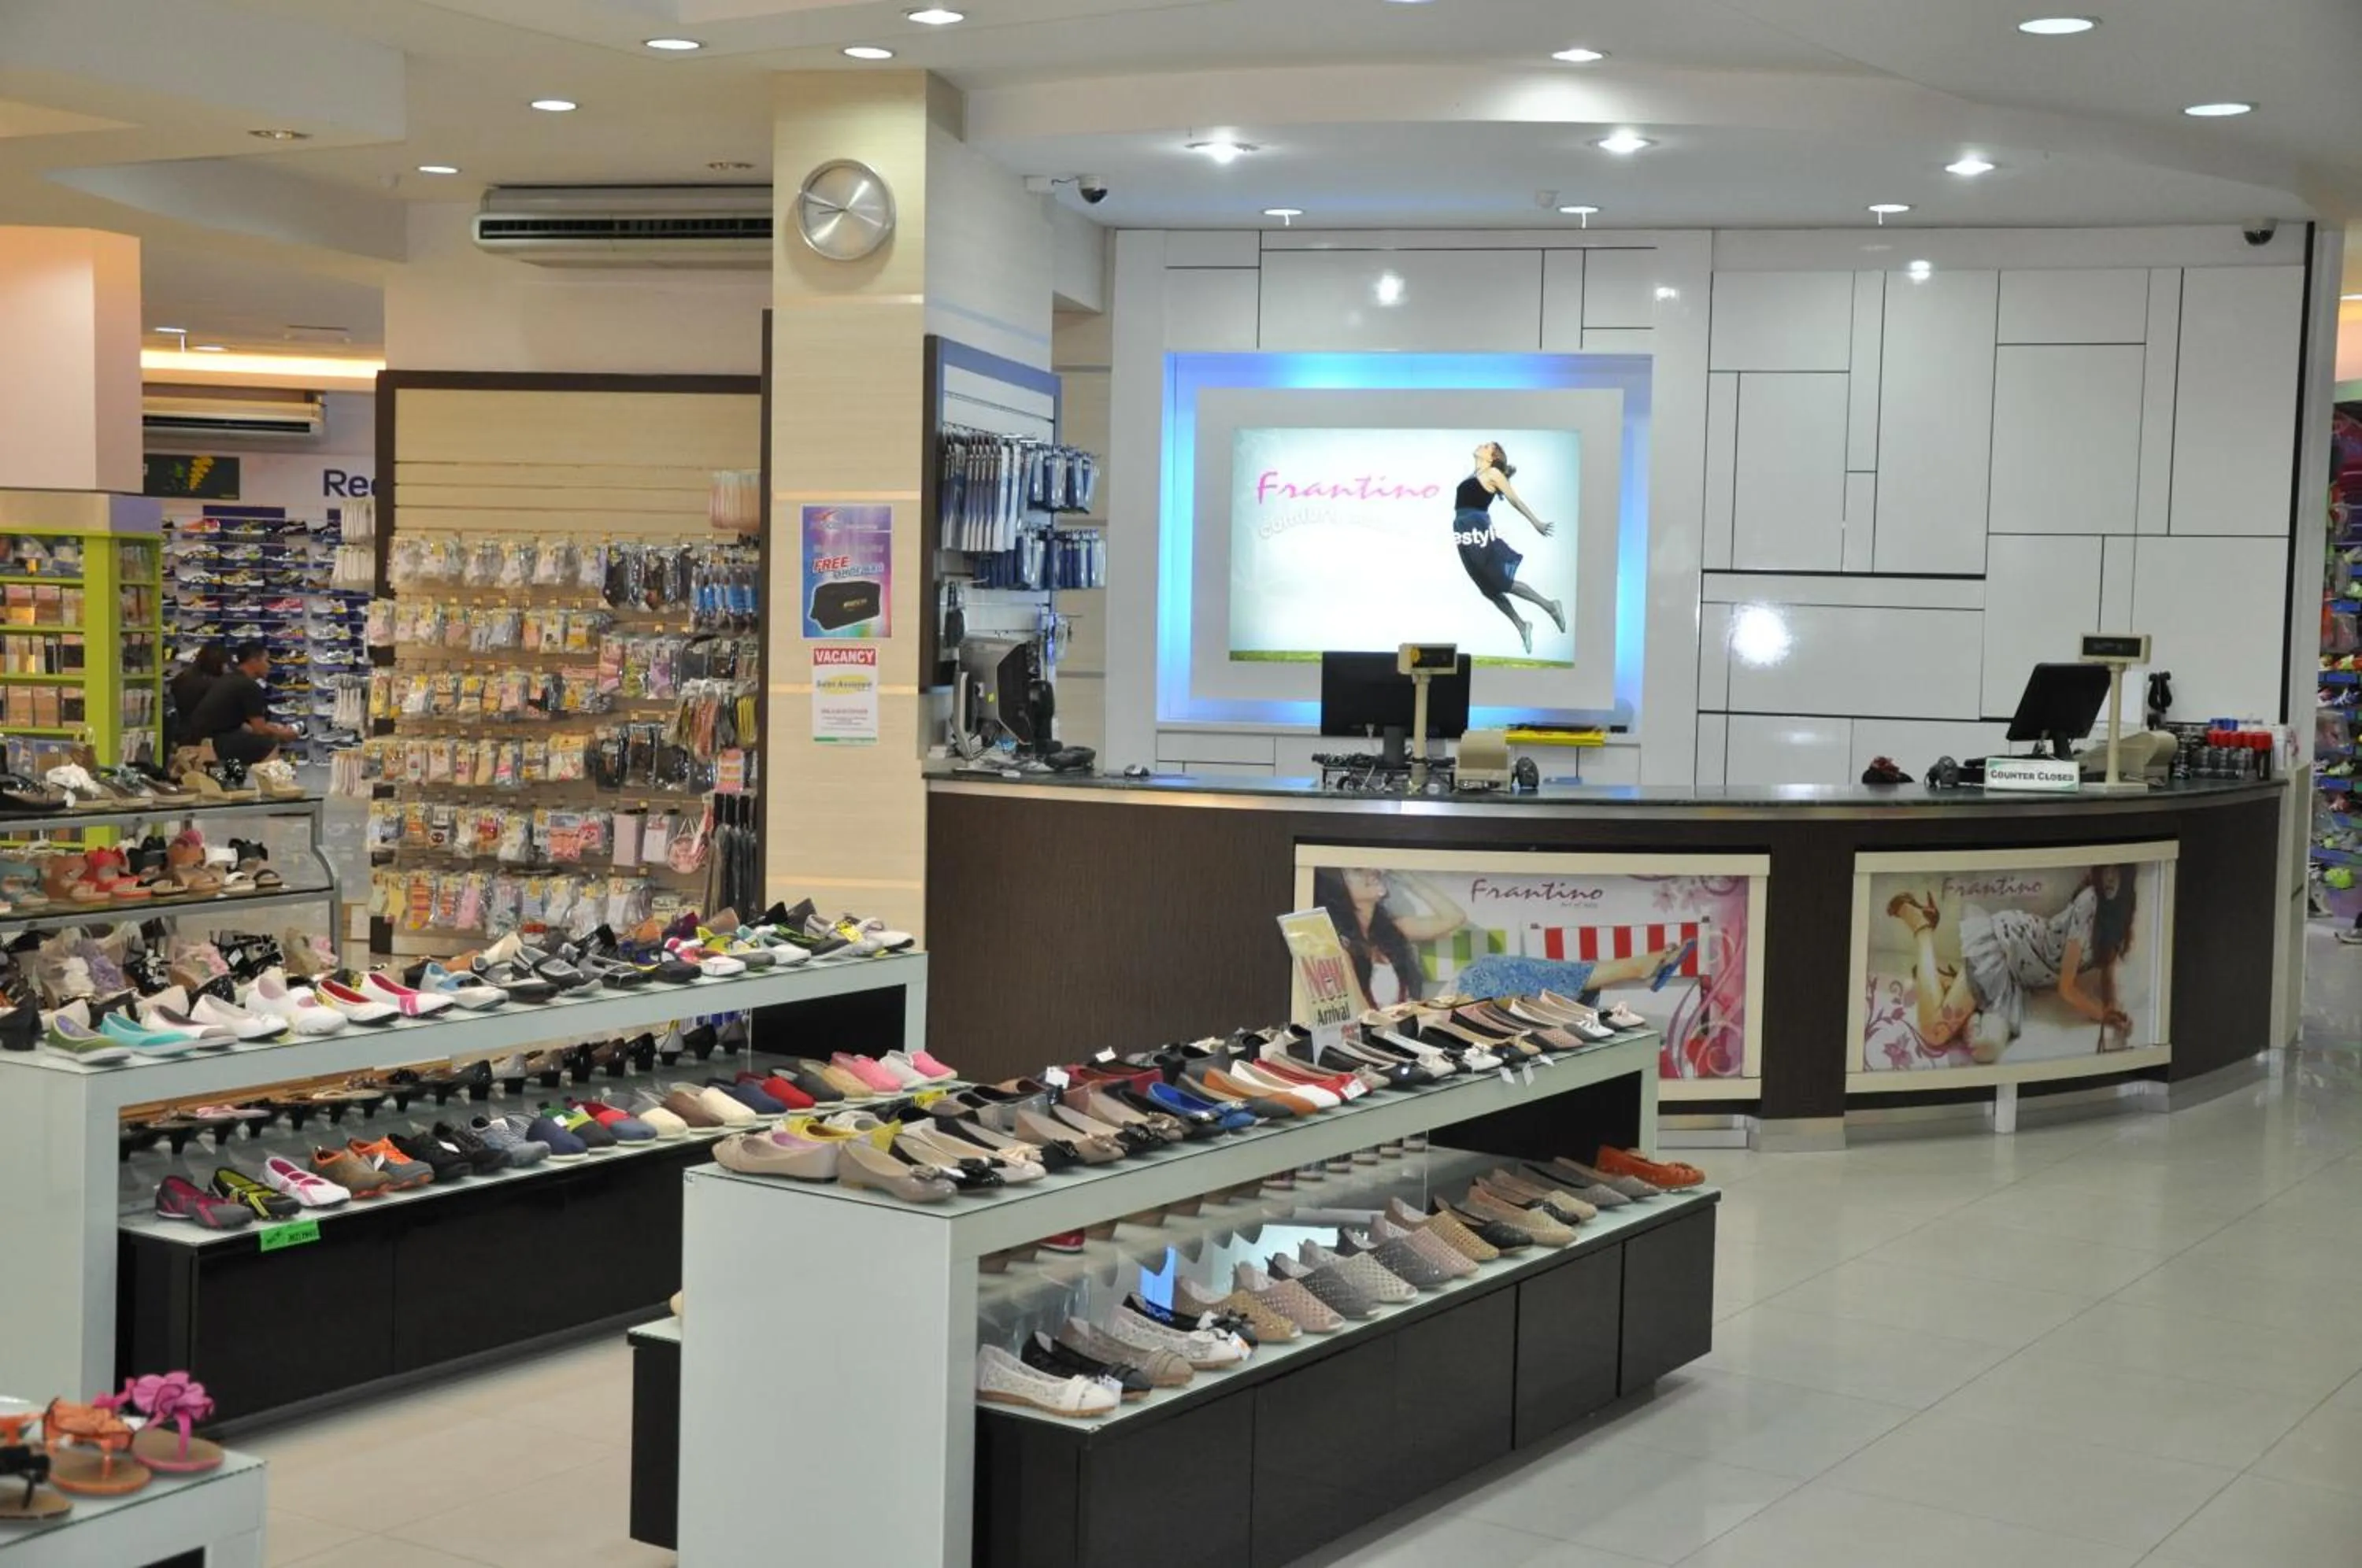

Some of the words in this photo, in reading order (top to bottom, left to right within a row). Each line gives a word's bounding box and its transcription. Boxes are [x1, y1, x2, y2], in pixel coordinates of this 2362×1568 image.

[1257, 472, 1440, 505] Frantino
[813, 556, 850, 572] FREE
[816, 649, 874, 663] VACANCY
[1990, 770, 2034, 780] COUNTER
[2035, 771, 2075, 782] CLOSED
[1472, 878, 1604, 904] Frantino
[1942, 877, 2042, 901] Frantino
[1316, 1001, 1351, 1026] Arrival
